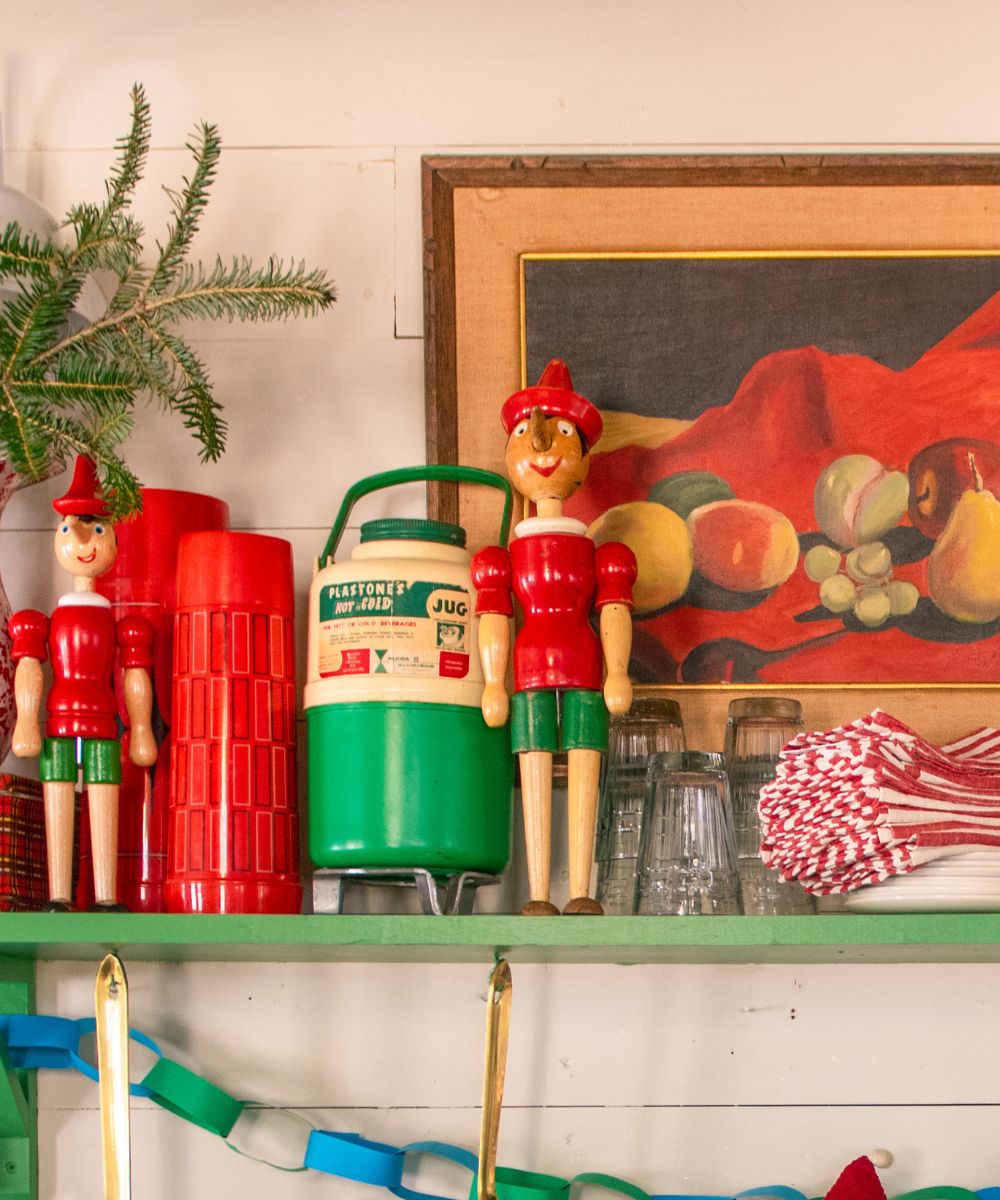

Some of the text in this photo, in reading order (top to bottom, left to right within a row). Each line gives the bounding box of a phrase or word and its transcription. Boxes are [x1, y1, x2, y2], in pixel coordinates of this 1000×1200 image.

[335, 601, 355, 615] HOT
[361, 596, 391, 611] COLD
[432, 598, 468, 617] JUG
[380, 620, 417, 628] BEVERAGES
